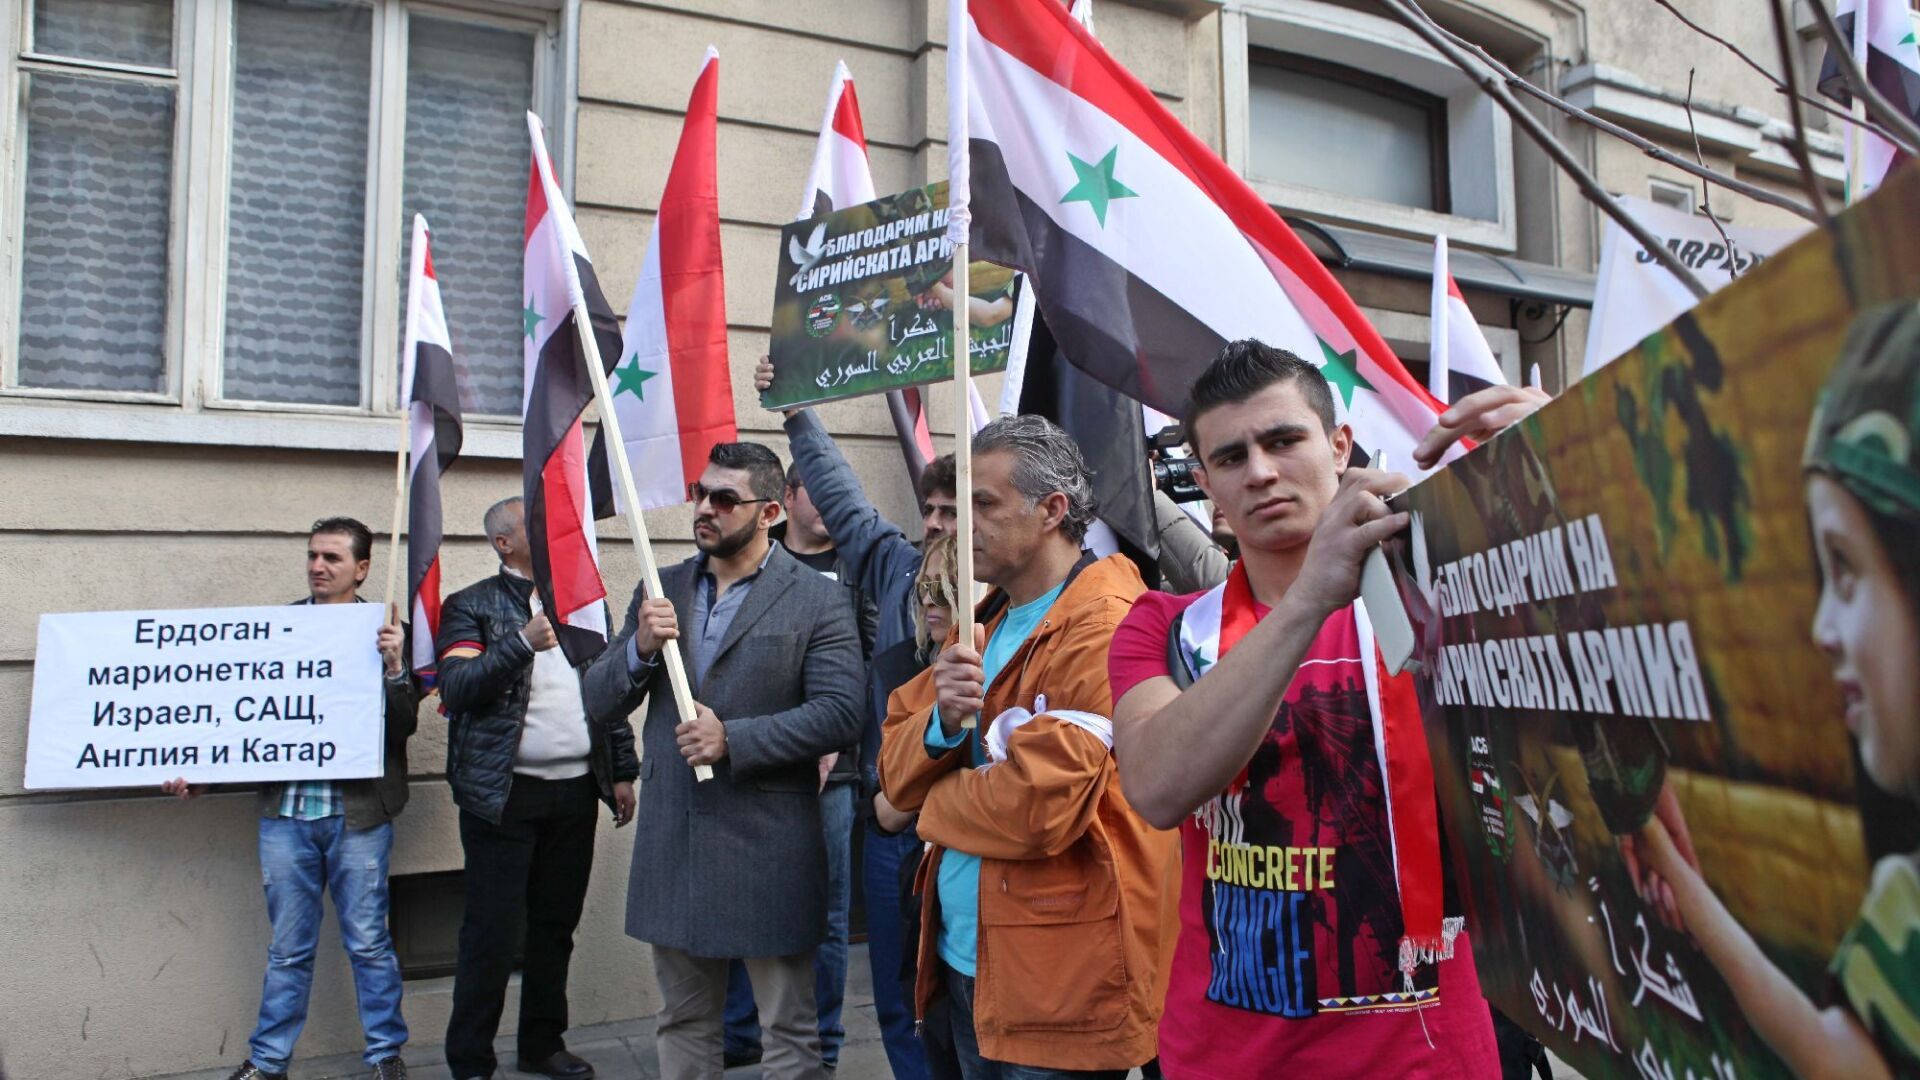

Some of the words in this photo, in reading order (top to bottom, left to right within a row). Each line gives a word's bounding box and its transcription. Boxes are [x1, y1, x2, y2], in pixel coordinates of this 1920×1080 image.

[826, 212, 929, 257] БЛАГОДАРИМ
[796, 247, 912, 293] СИРИЙСКАТА
[1566, 513, 1618, 592] НА
[135, 618, 270, 649] Ердоган
[88, 660, 284, 690] марионетка
[296, 659, 333, 680] на
[1567, 620, 1711, 722] АРМИЯ
[93, 700, 222, 731] Израел,
[234, 694, 324, 725] САЩ,
[76, 743, 198, 769] Англия
[211, 745, 229, 765] и
[242, 737, 337, 768] Катар
[1206, 839, 1336, 891] CONCRETE
[1206, 883, 1313, 1018] JUNGLE
